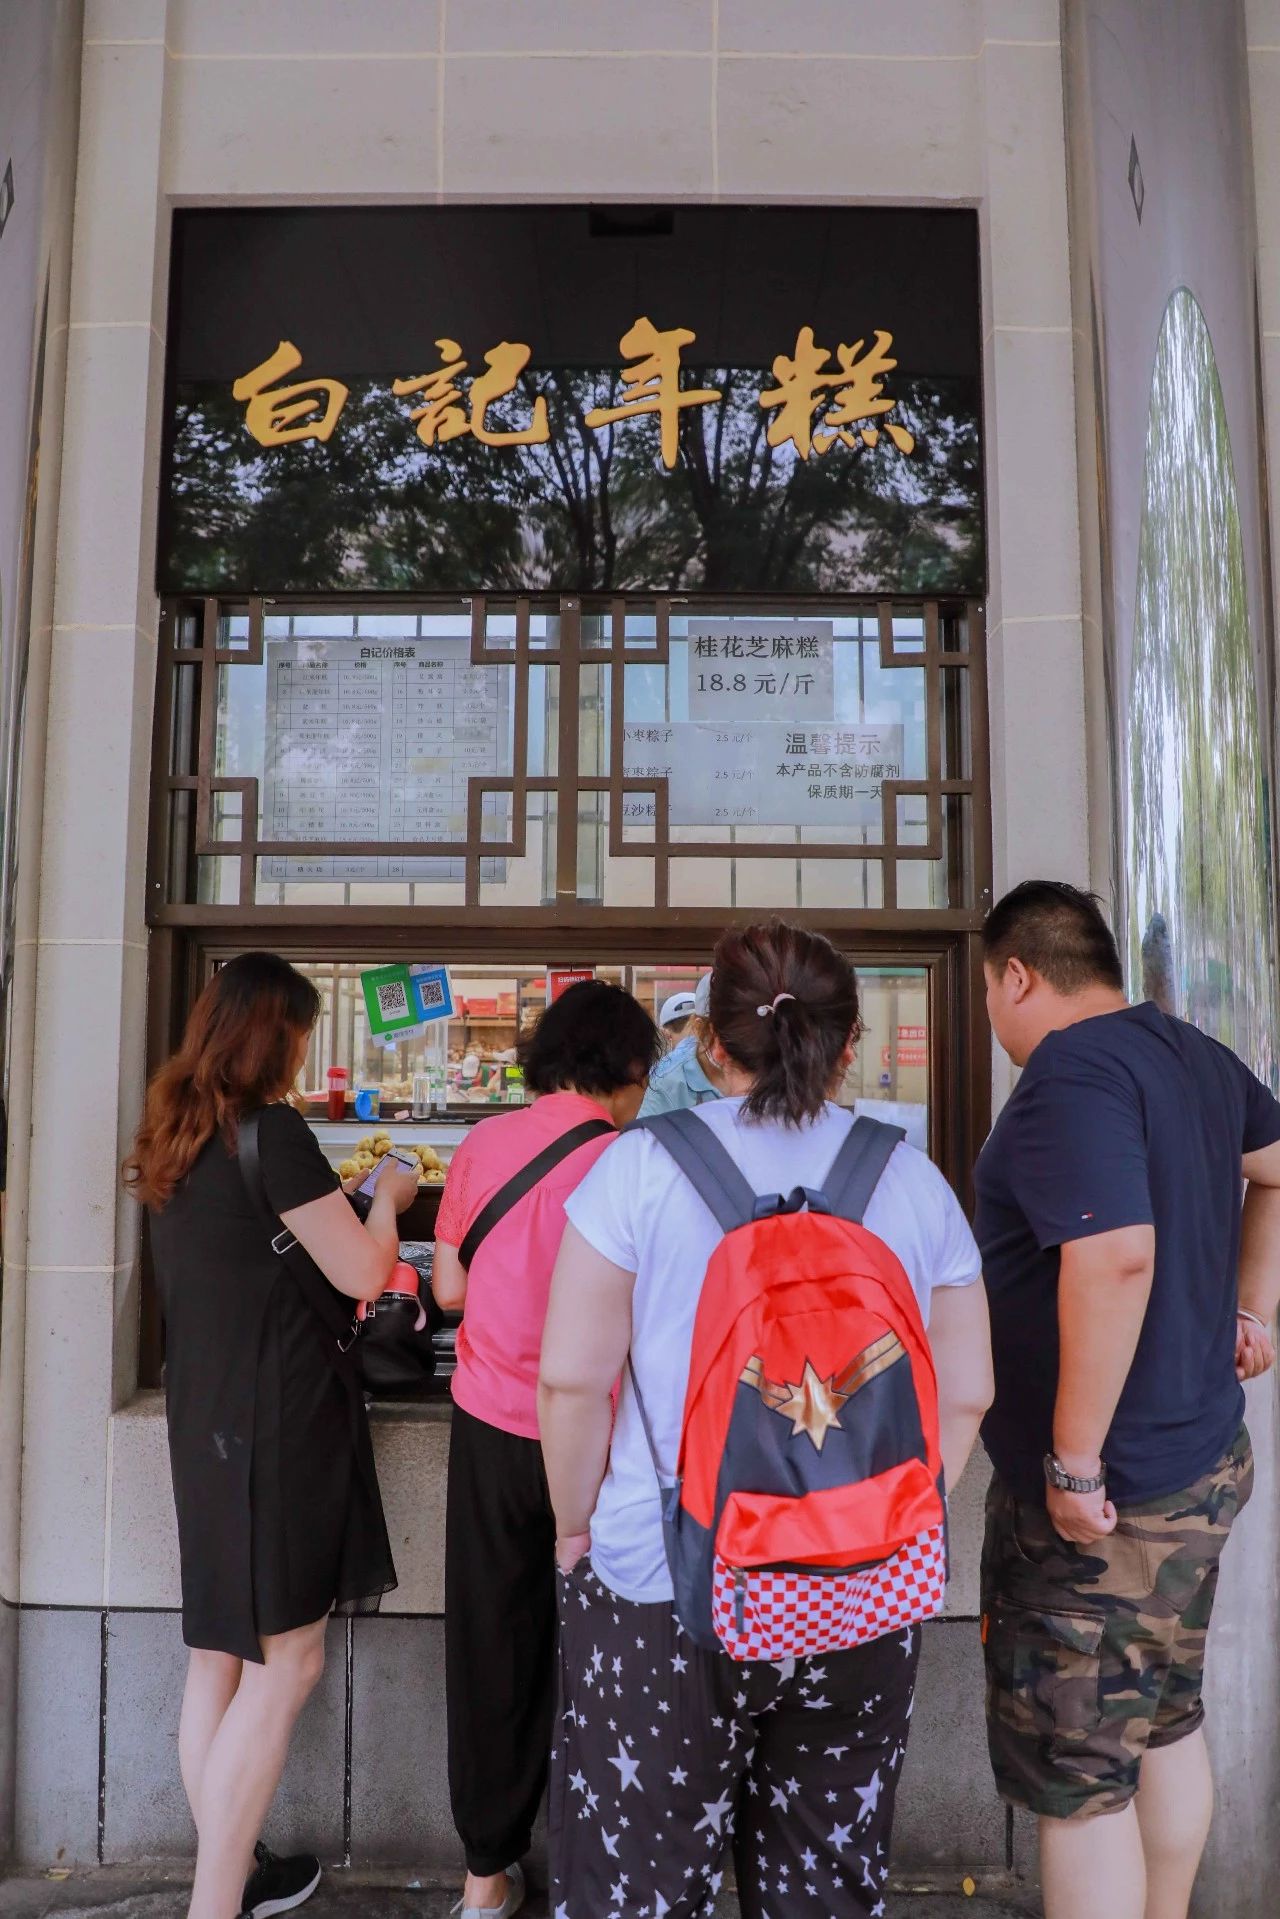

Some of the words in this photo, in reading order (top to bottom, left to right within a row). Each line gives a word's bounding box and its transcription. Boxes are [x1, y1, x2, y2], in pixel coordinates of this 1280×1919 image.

[232, 316, 915, 468] 白記年糕
[360, 647, 416, 659] 白记价格表
[694, 635, 820, 659] 桂花芝麻糕
[697, 673, 747, 692] 18.8
[753, 672, 815, 695] 元/斤
[716, 734, 729, 742] 2.5
[732, 731, 752, 743] 元/个
[785, 733, 881, 755] 温馨提示
[715, 770, 729, 779] 2.5
[732, 769, 752, 780] 元/个
[776, 763, 900, 778] 本产品不含防腐剂
[807, 784, 883, 799] 保质期一天
[623, 804, 672, 816] 豆沙粽
[715, 808, 729, 816] 2.5
[732, 806, 755, 817] 元/个
